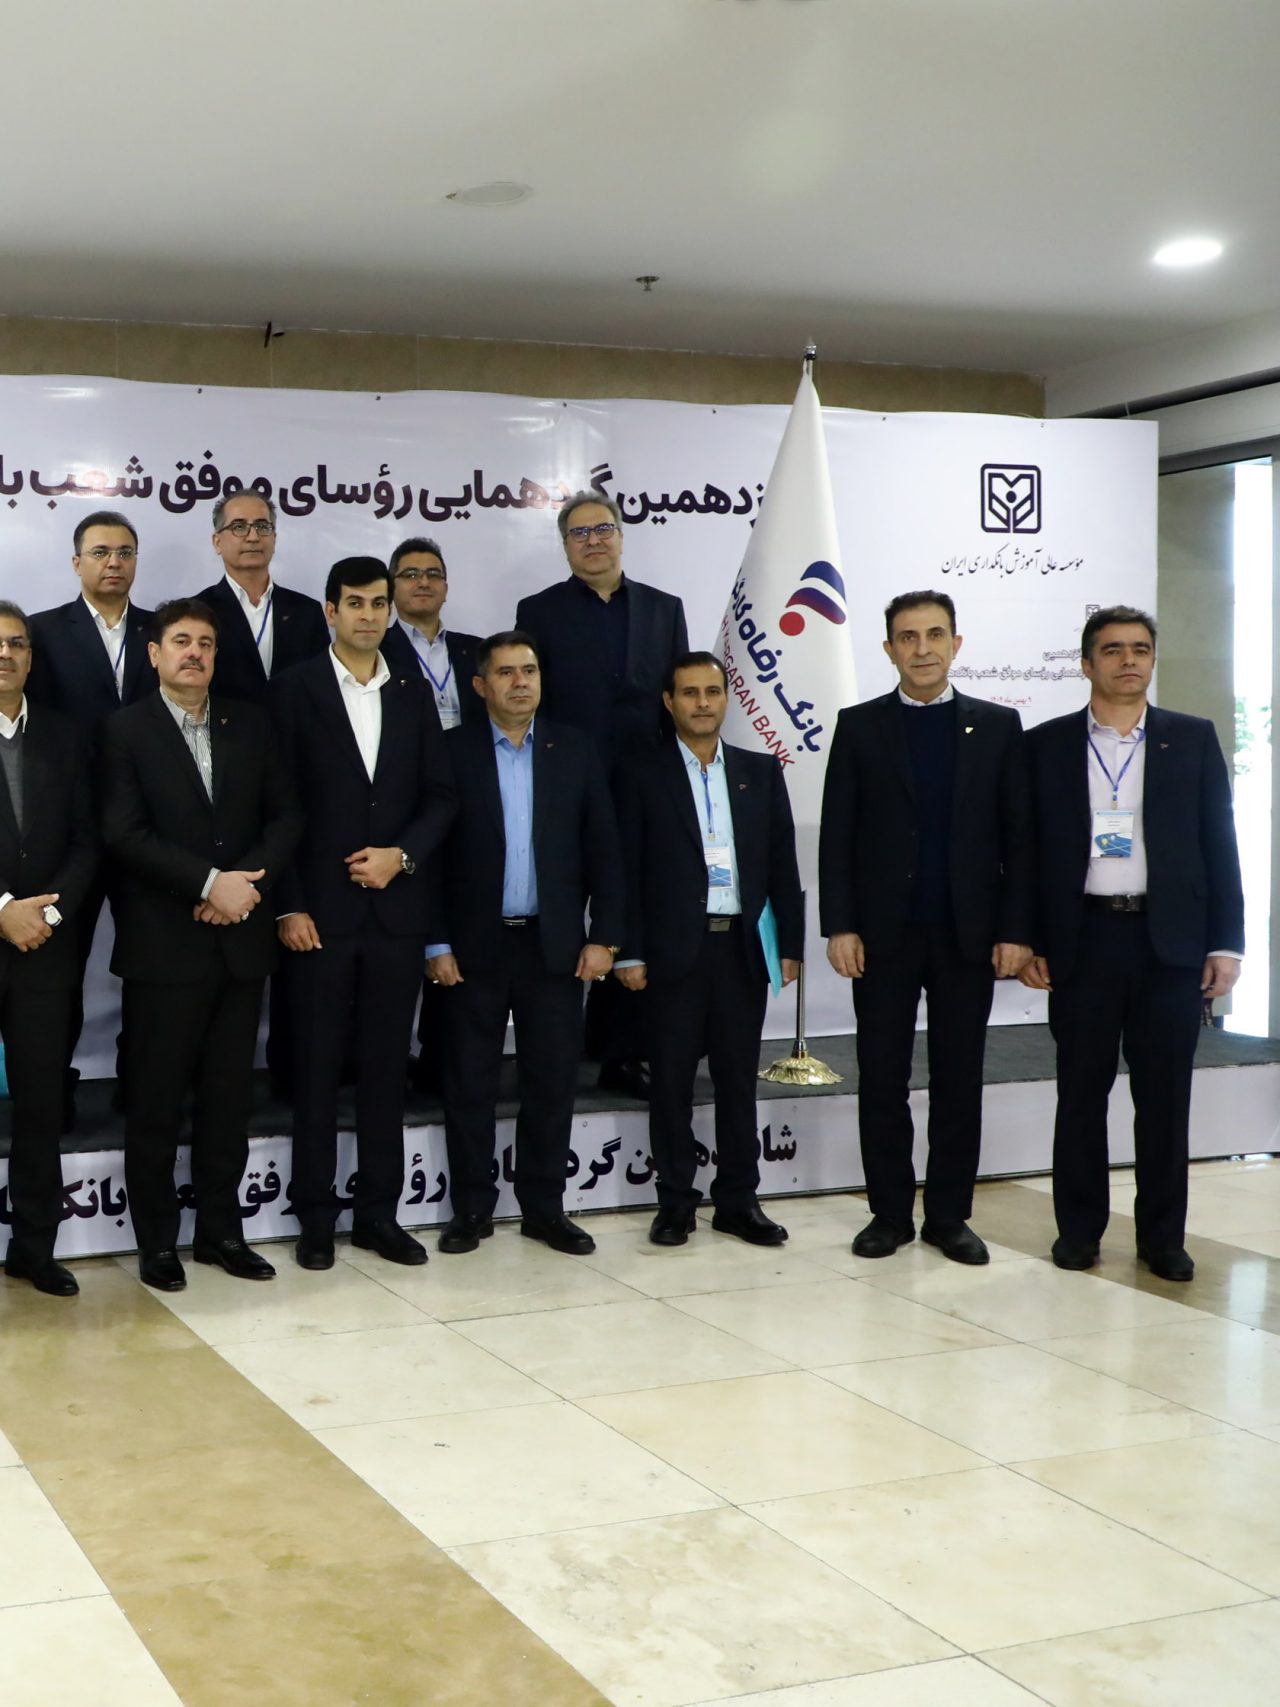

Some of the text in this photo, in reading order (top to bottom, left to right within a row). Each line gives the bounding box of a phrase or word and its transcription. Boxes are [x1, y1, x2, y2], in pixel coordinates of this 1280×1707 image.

[29, 455, 153, 510] شعب
[160, 450, 273, 513] موفق
[279, 463, 413, 520] رؤسای
[419, 463, 614, 522] گدهمایی
[616, 483, 764, 528] دهمین
[941, 555, 967, 576] ایران
[968, 542, 1010, 578] بانکداری
[1005, 547, 1043, 574] آموزش
[1040, 554, 1057, 575] عالی
[738, 618, 783, 684] رفاه
[752, 714, 796, 771] BANK
[773, 682, 824, 752] بانک
